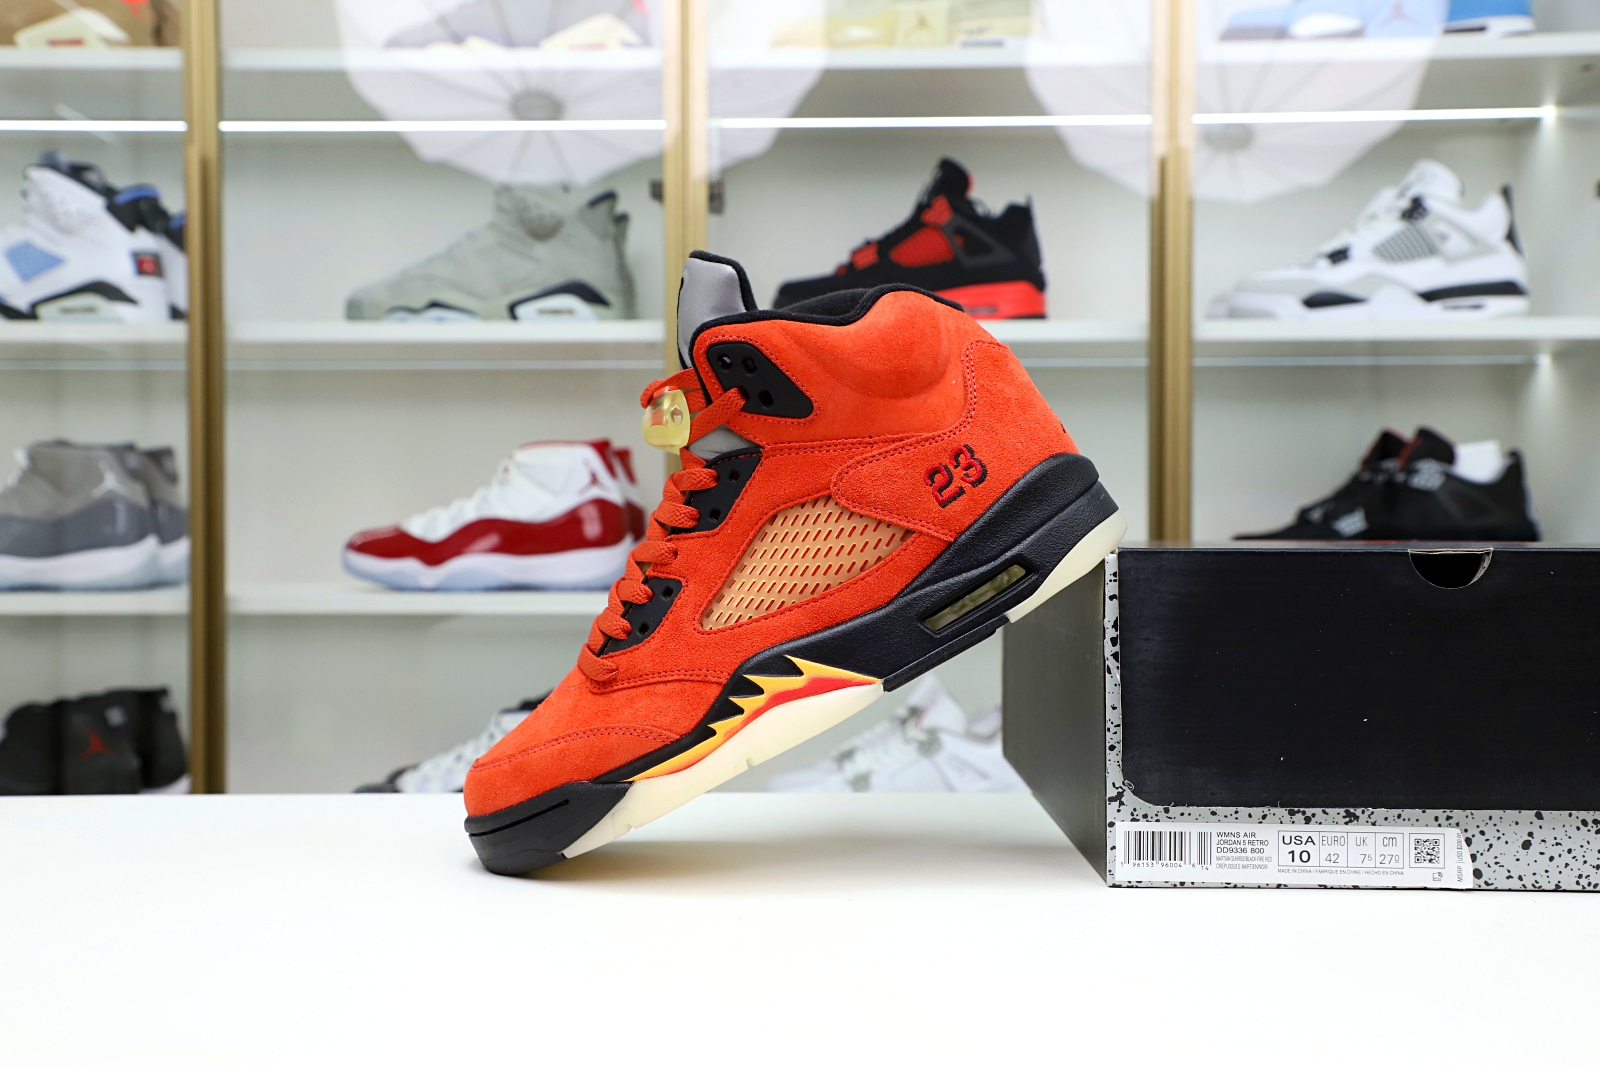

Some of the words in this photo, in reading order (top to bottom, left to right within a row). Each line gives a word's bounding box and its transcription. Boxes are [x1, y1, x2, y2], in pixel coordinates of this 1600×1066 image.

[923, 444, 988, 508] 23
[1243, 831, 1257, 839] AIR
[1247, 839, 1269, 847] RETRO
[1282, 835, 1316, 846] USA
[1321, 835, 1346, 847] EURO
[1355, 836, 1369, 847] UK
[1382, 836, 1398, 848] cm
[1250, 847, 1265, 855] 800
[1288, 849, 1311, 863] 10
[1324, 853, 1340, 864] 42
